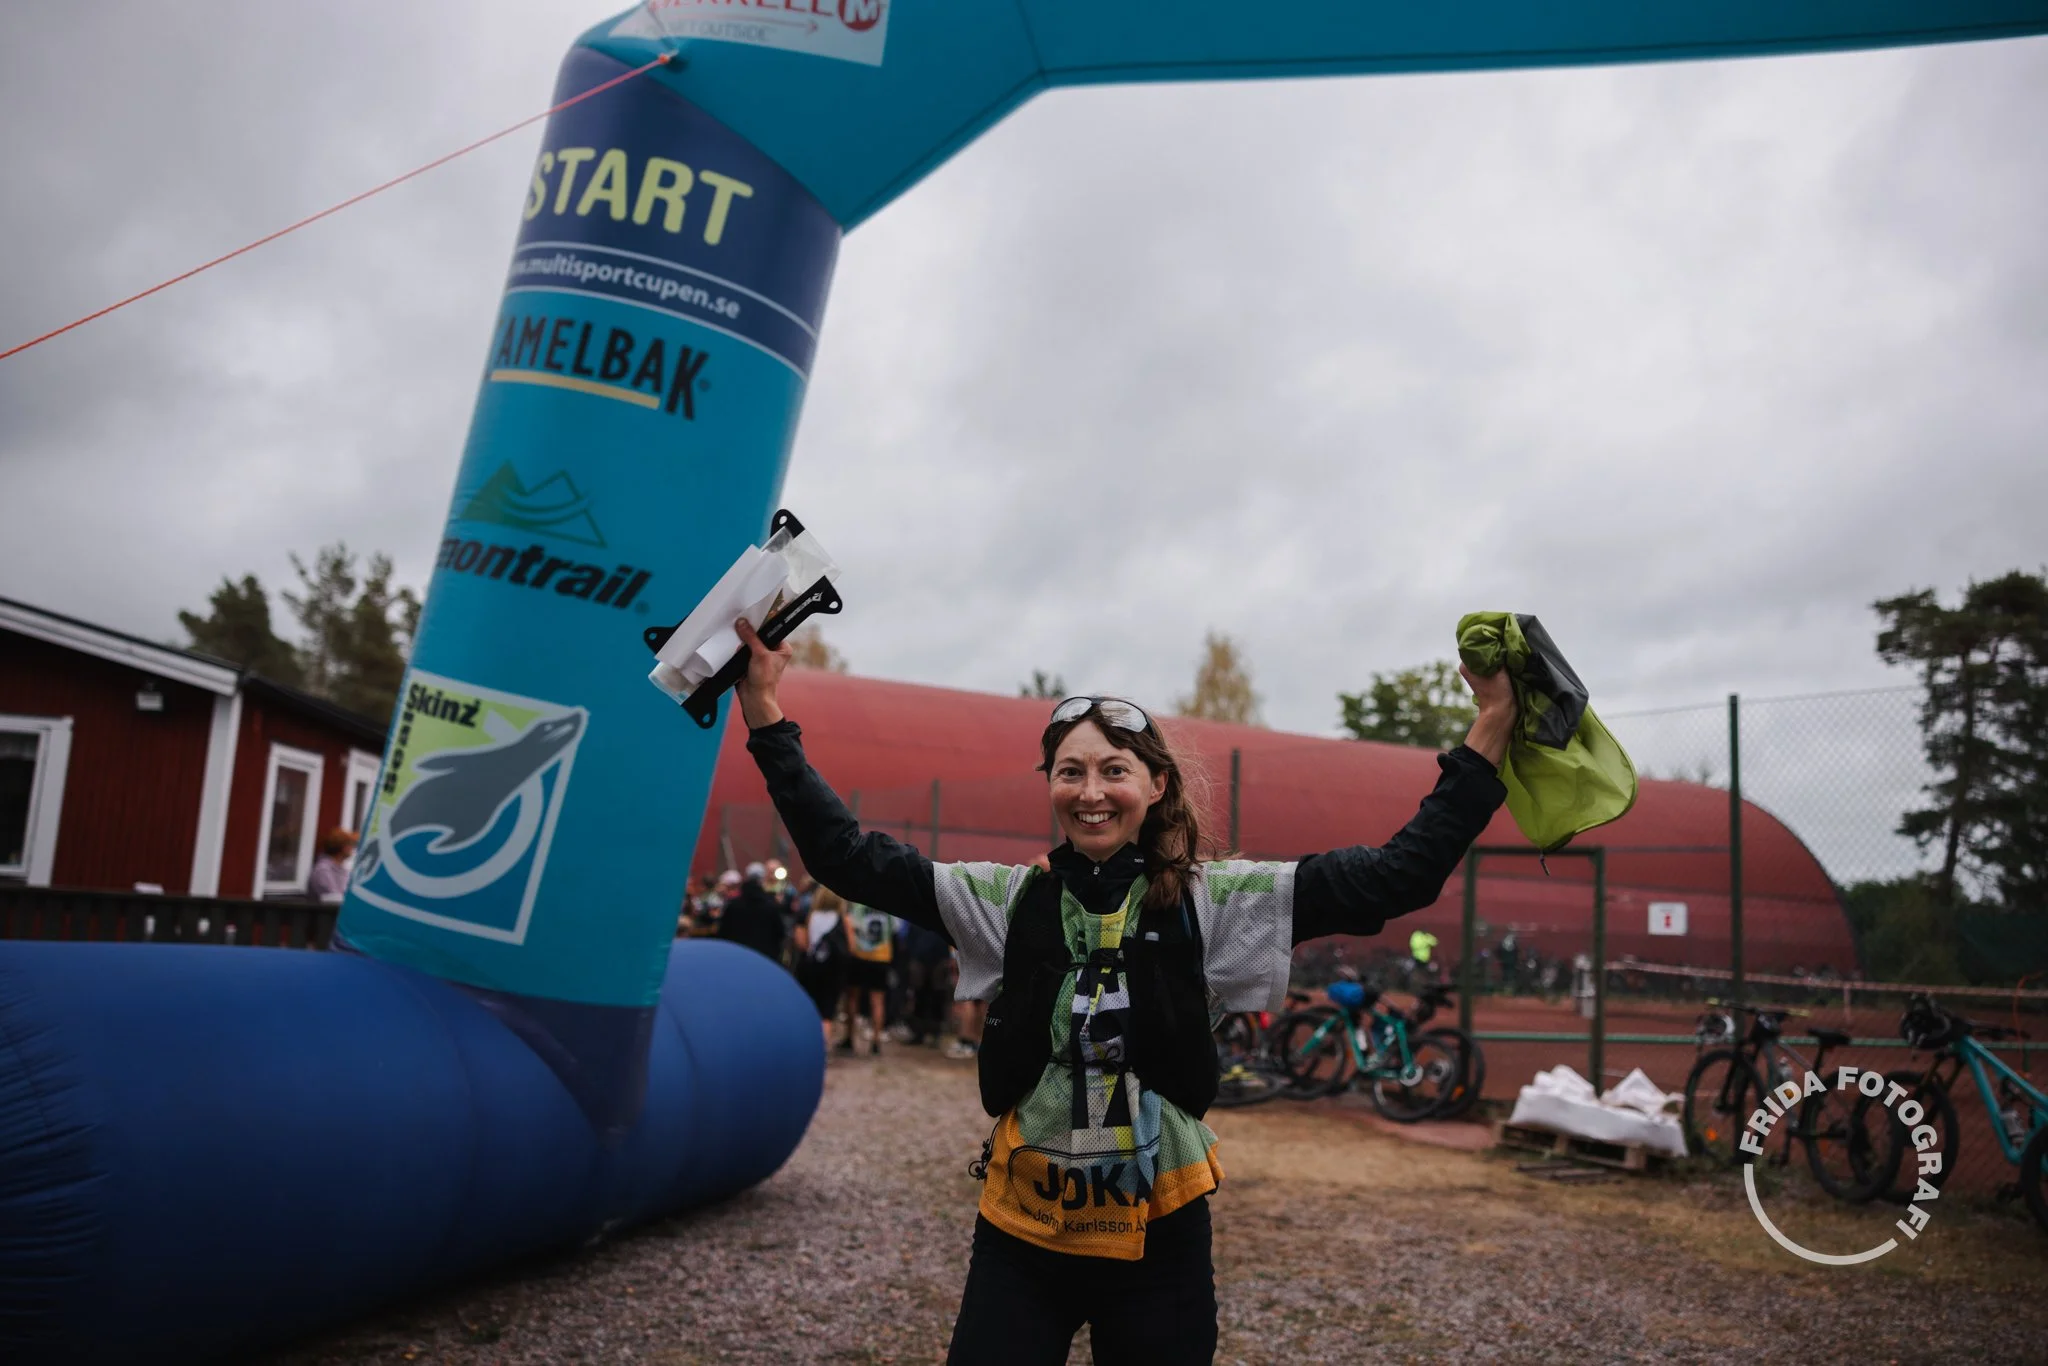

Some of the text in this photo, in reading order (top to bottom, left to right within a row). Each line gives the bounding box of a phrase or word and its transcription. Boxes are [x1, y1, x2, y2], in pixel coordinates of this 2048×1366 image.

[523, 147, 754, 246] START
[488, 314, 709, 421] AMELBAK
[1064, 1219, 1133, 1233] Karlsson
